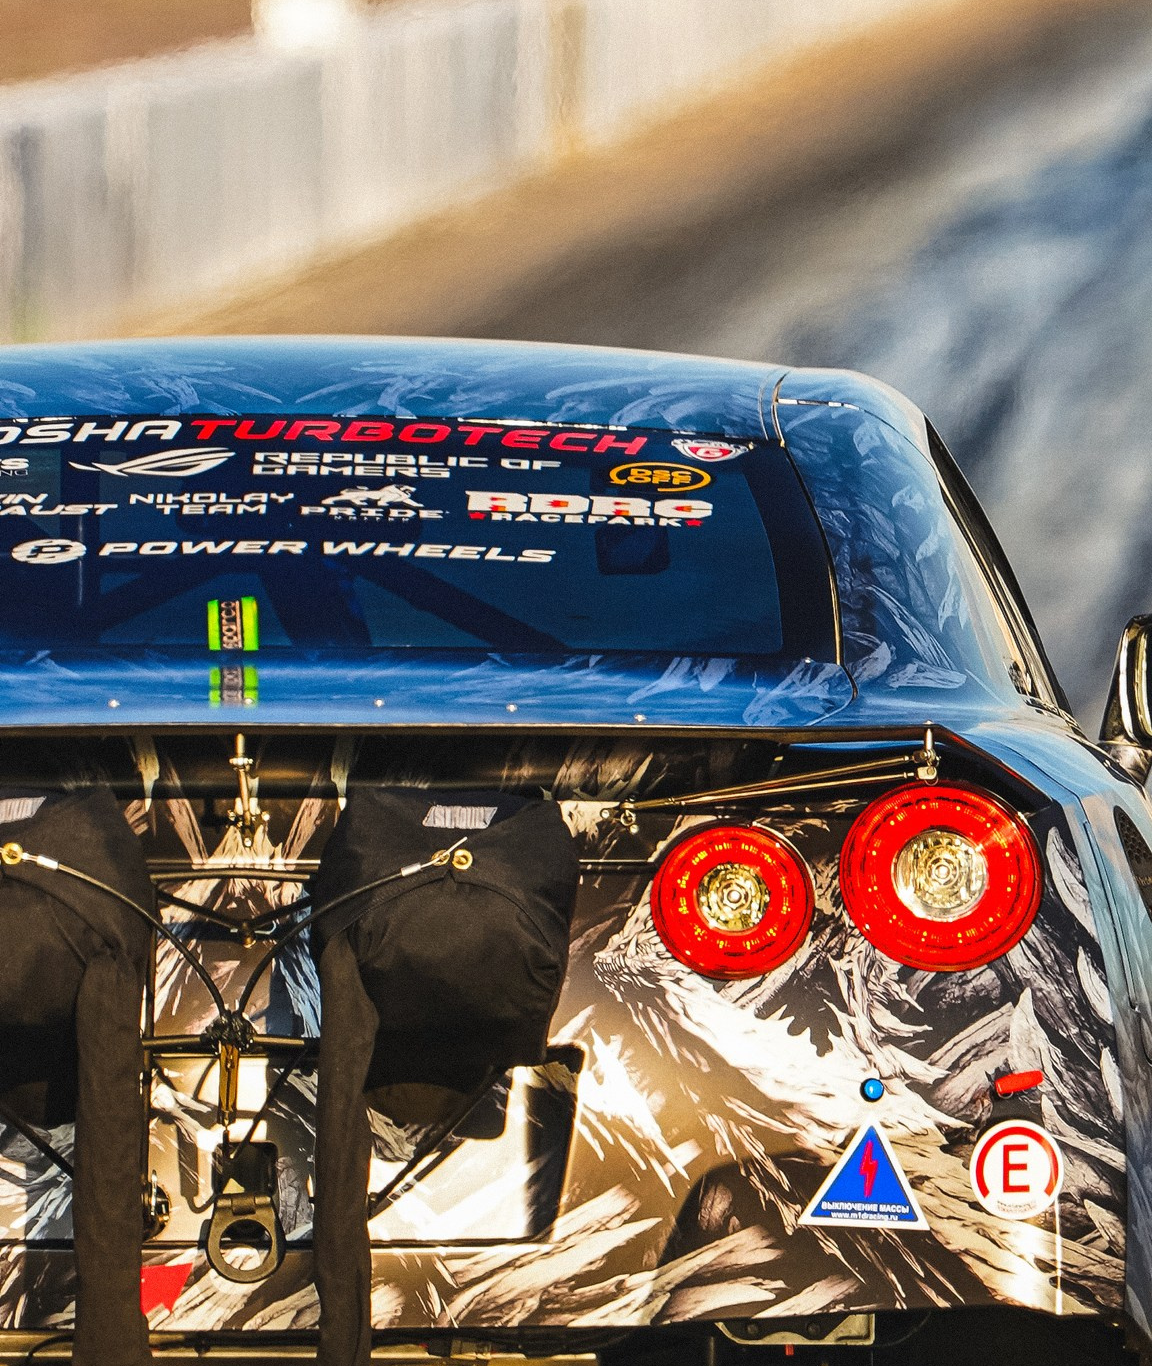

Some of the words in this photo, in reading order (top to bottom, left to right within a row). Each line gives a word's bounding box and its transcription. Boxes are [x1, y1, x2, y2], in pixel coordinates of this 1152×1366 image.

[190, 419, 648, 455] TURBOTECH
[254, 452, 489, 468] REPUBLIC
[500, 457, 562, 471] OF
[253, 464, 450, 478] GAMERS
[630, 468, 692, 477] DSC
[627, 475, 692, 486] OFF
[129, 492, 295, 505] NIKOLAY
[465, 490, 714, 519] RDRC
[155, 503, 268, 516] TEAM
[300, 505, 445, 519] PRIDE
[491, 512, 682, 527] RACEPARK
[98, 540, 309, 557] POWER
[322, 541, 557, 563] WHEELS
[1002, 1143, 1030, 1193] E
[821, 1201, 879, 1212] ВЫКЛЮЧЕНИЕ
[879, 1203, 910, 1214] МАССЫ
